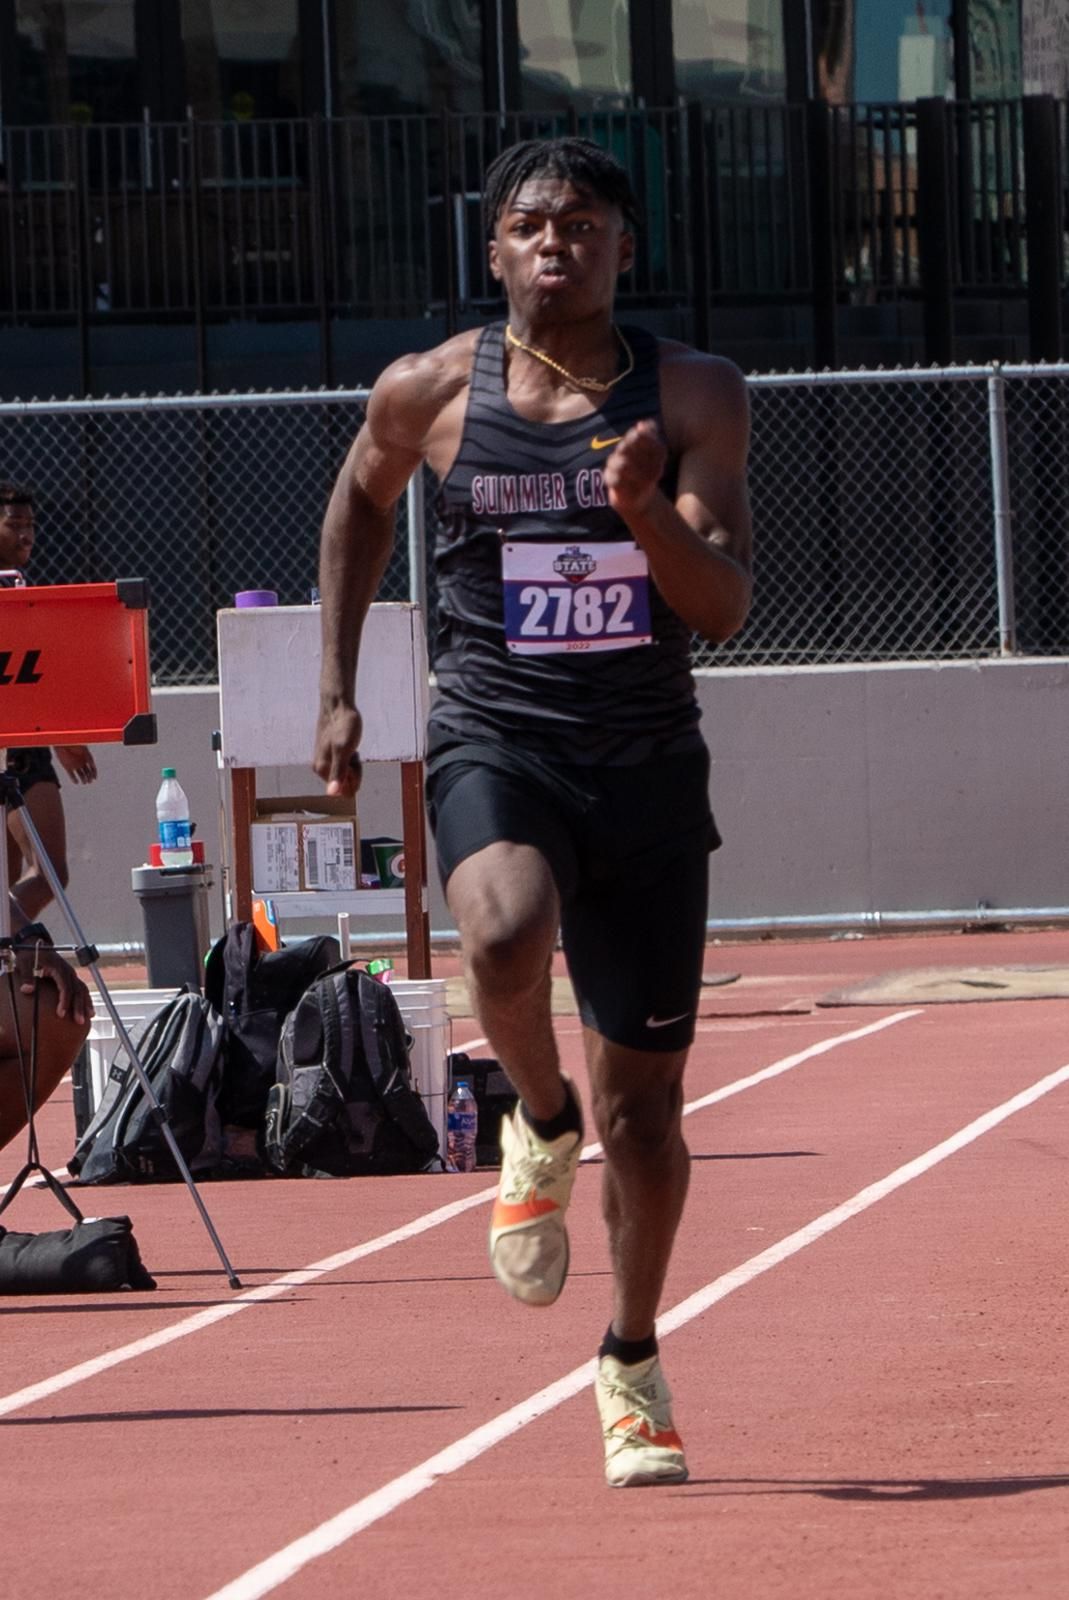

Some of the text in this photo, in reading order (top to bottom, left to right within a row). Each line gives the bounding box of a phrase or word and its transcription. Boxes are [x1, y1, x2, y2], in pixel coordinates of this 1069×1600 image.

[472, 468, 608, 515] SUMMER CR
[552, 560, 597, 572] STATE
[519, 583, 634, 636] 2782
[565, 641, 592, 651] 2022
